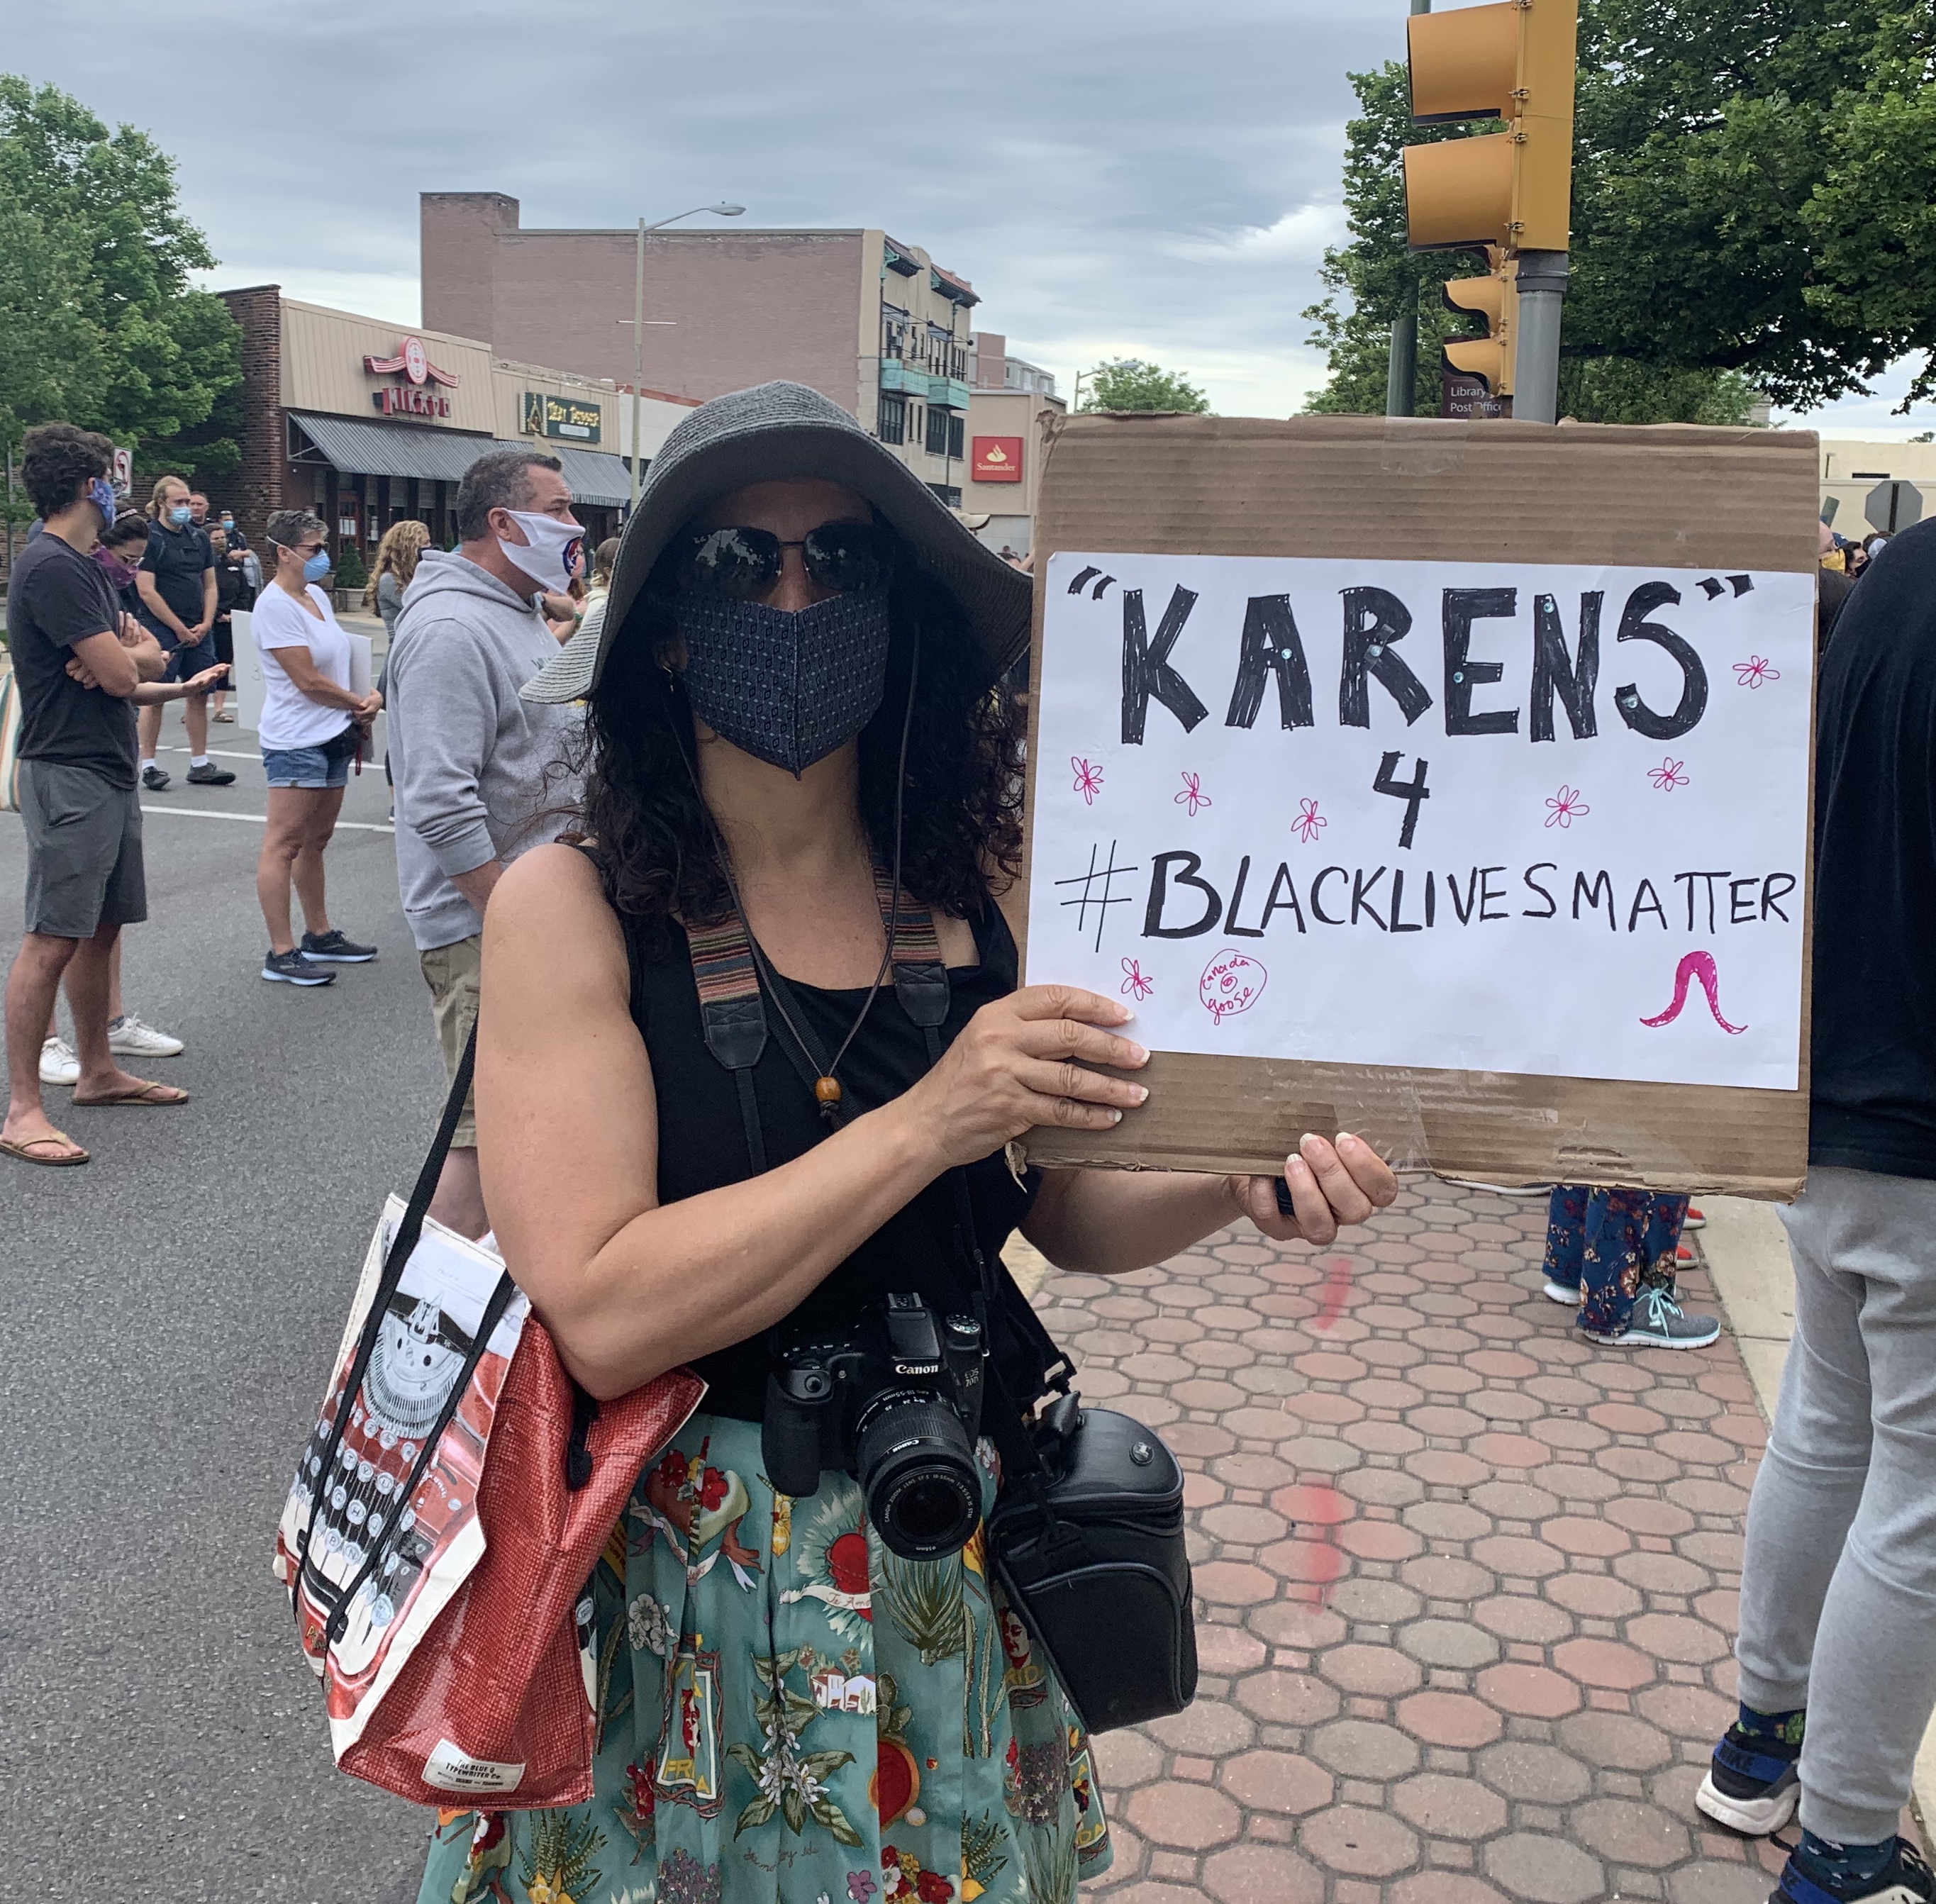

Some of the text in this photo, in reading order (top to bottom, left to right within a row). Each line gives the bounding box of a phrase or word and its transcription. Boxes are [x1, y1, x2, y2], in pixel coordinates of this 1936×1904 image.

[1450, 386, 1486, 399] Library
[1450, 402, 1472, 412] Post
[976, 462, 1016, 472] Santander
[1372, 751, 1430, 850] 4
[895, 1364, 939, 1375] Canon
[892, 1439, 920, 1454] Canon
[445, 1762, 490, 1778] TYPEWRITER
